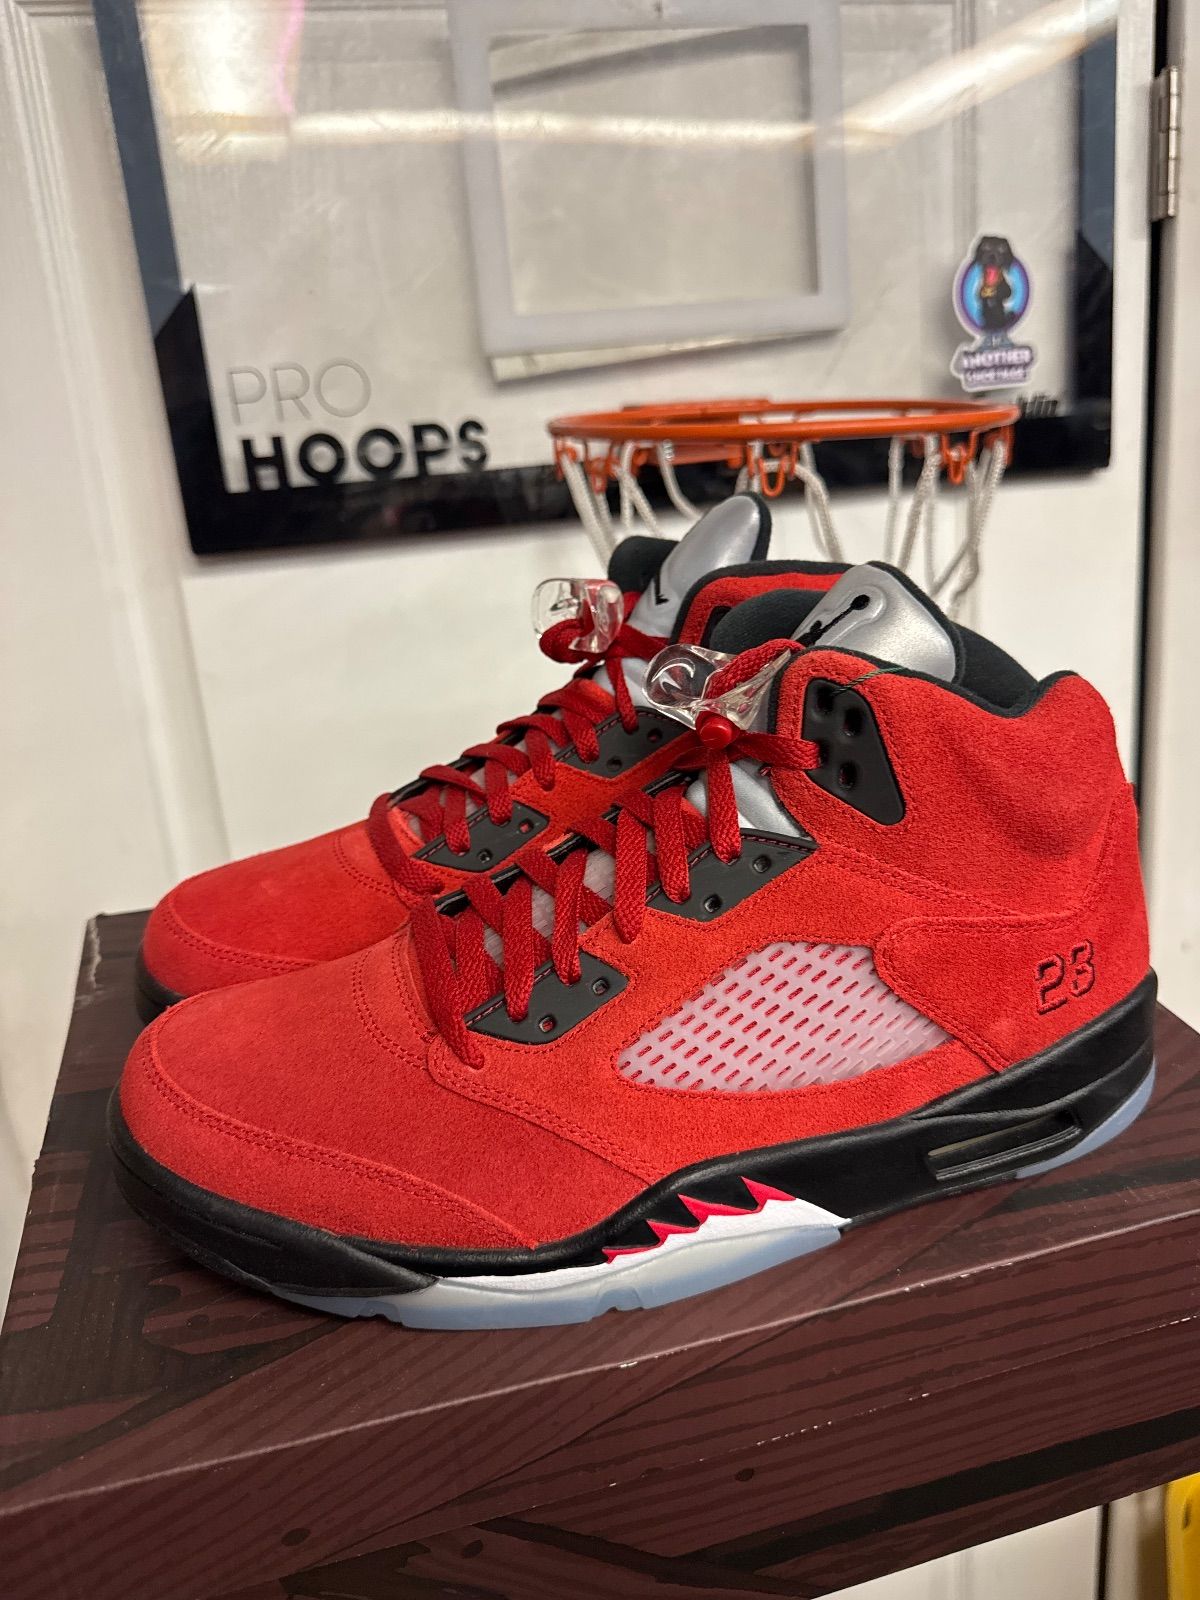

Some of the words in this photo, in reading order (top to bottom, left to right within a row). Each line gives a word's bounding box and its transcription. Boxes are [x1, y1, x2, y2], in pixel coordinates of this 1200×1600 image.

[226, 358, 372, 425] PRO
[240, 419, 488, 491] HOOPS
[1035, 938, 1096, 1016] 23
